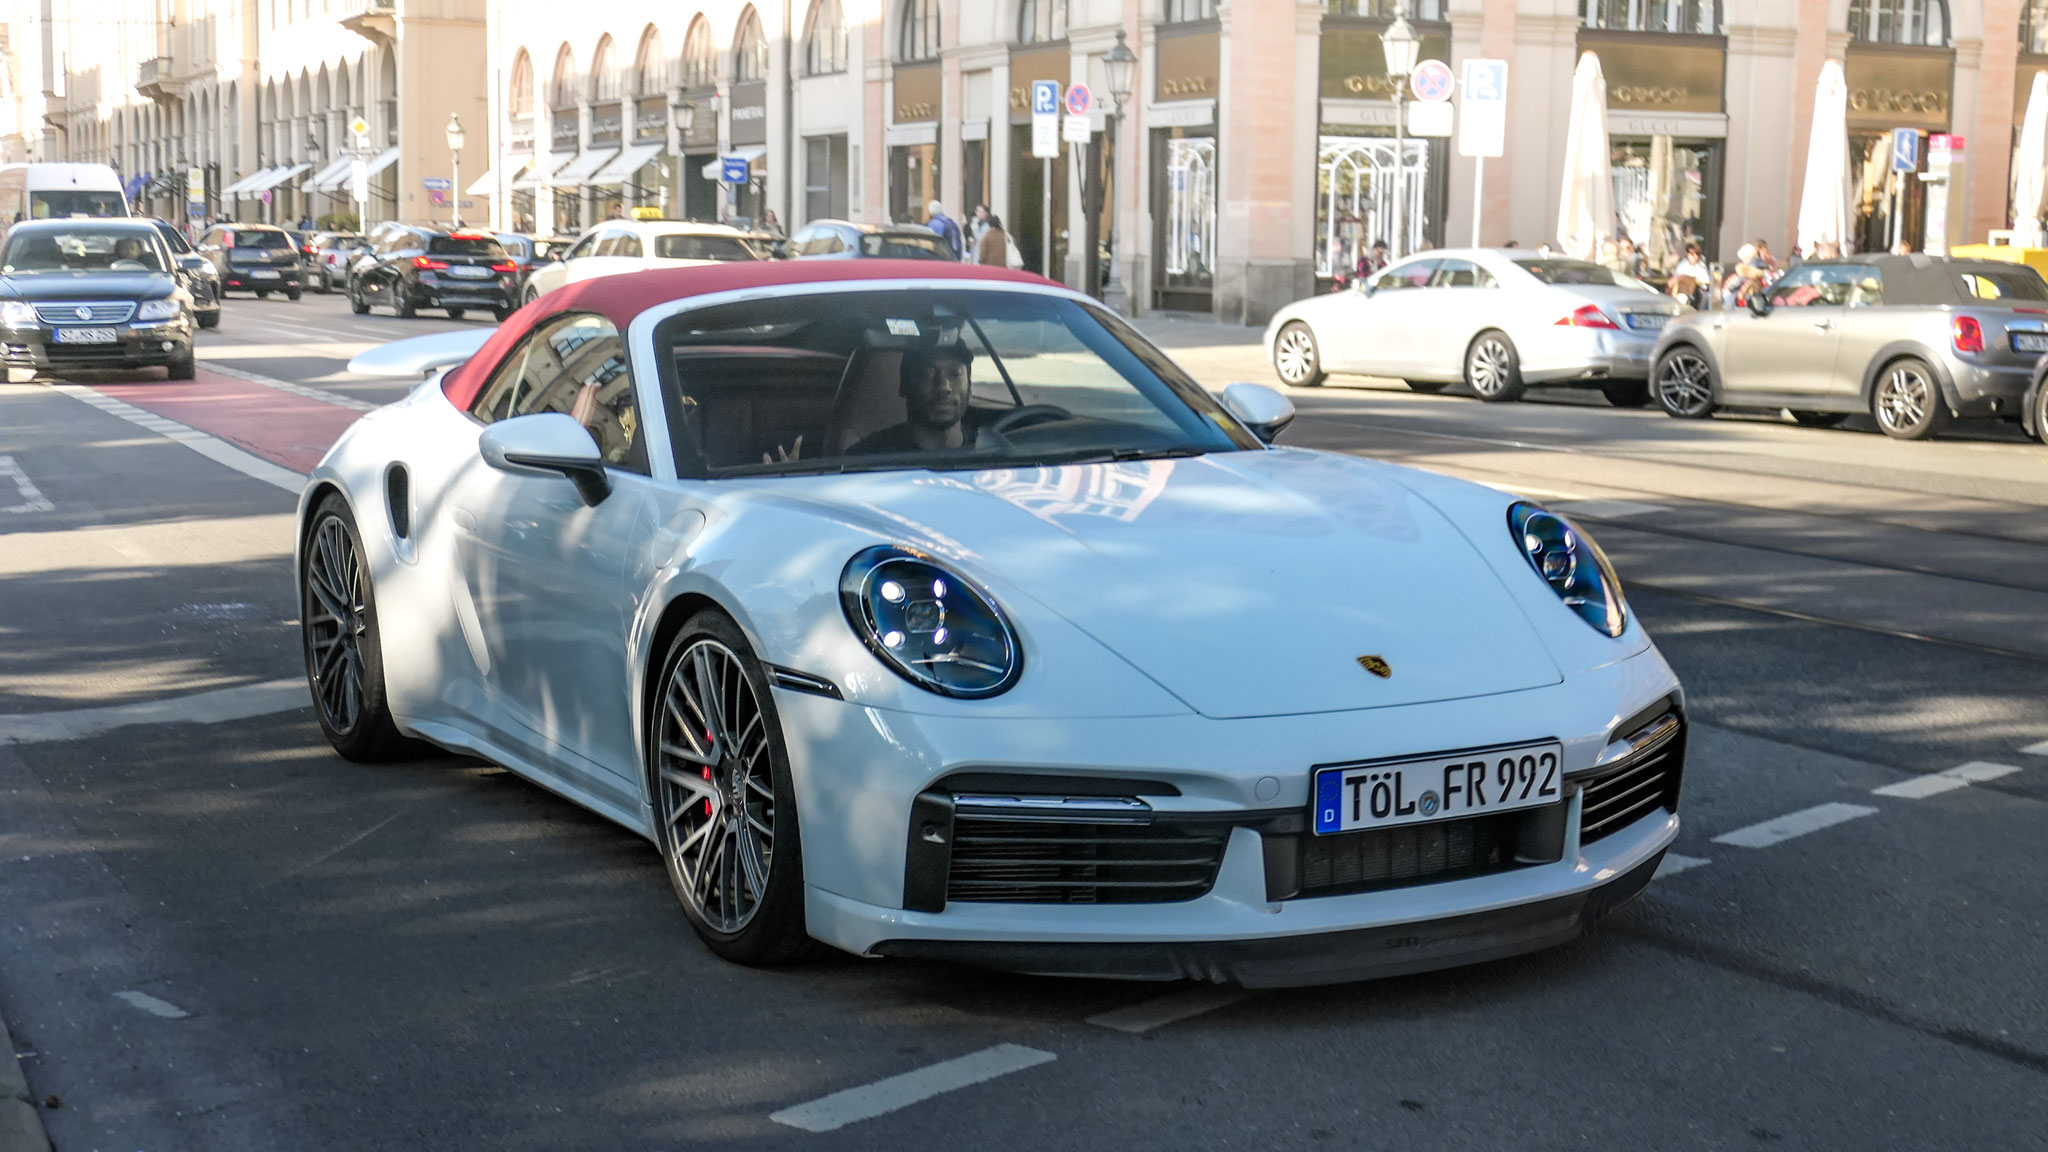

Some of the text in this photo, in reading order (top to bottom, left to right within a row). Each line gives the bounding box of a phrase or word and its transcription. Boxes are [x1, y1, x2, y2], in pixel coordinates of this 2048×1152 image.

[1036, 84, 1053, 112] P
[1612, 87, 1688, 104] GUCCI
[1849, 90, 1948, 113] GUCCI
[1324, 752, 1557, 823] D TÖL FR 992
